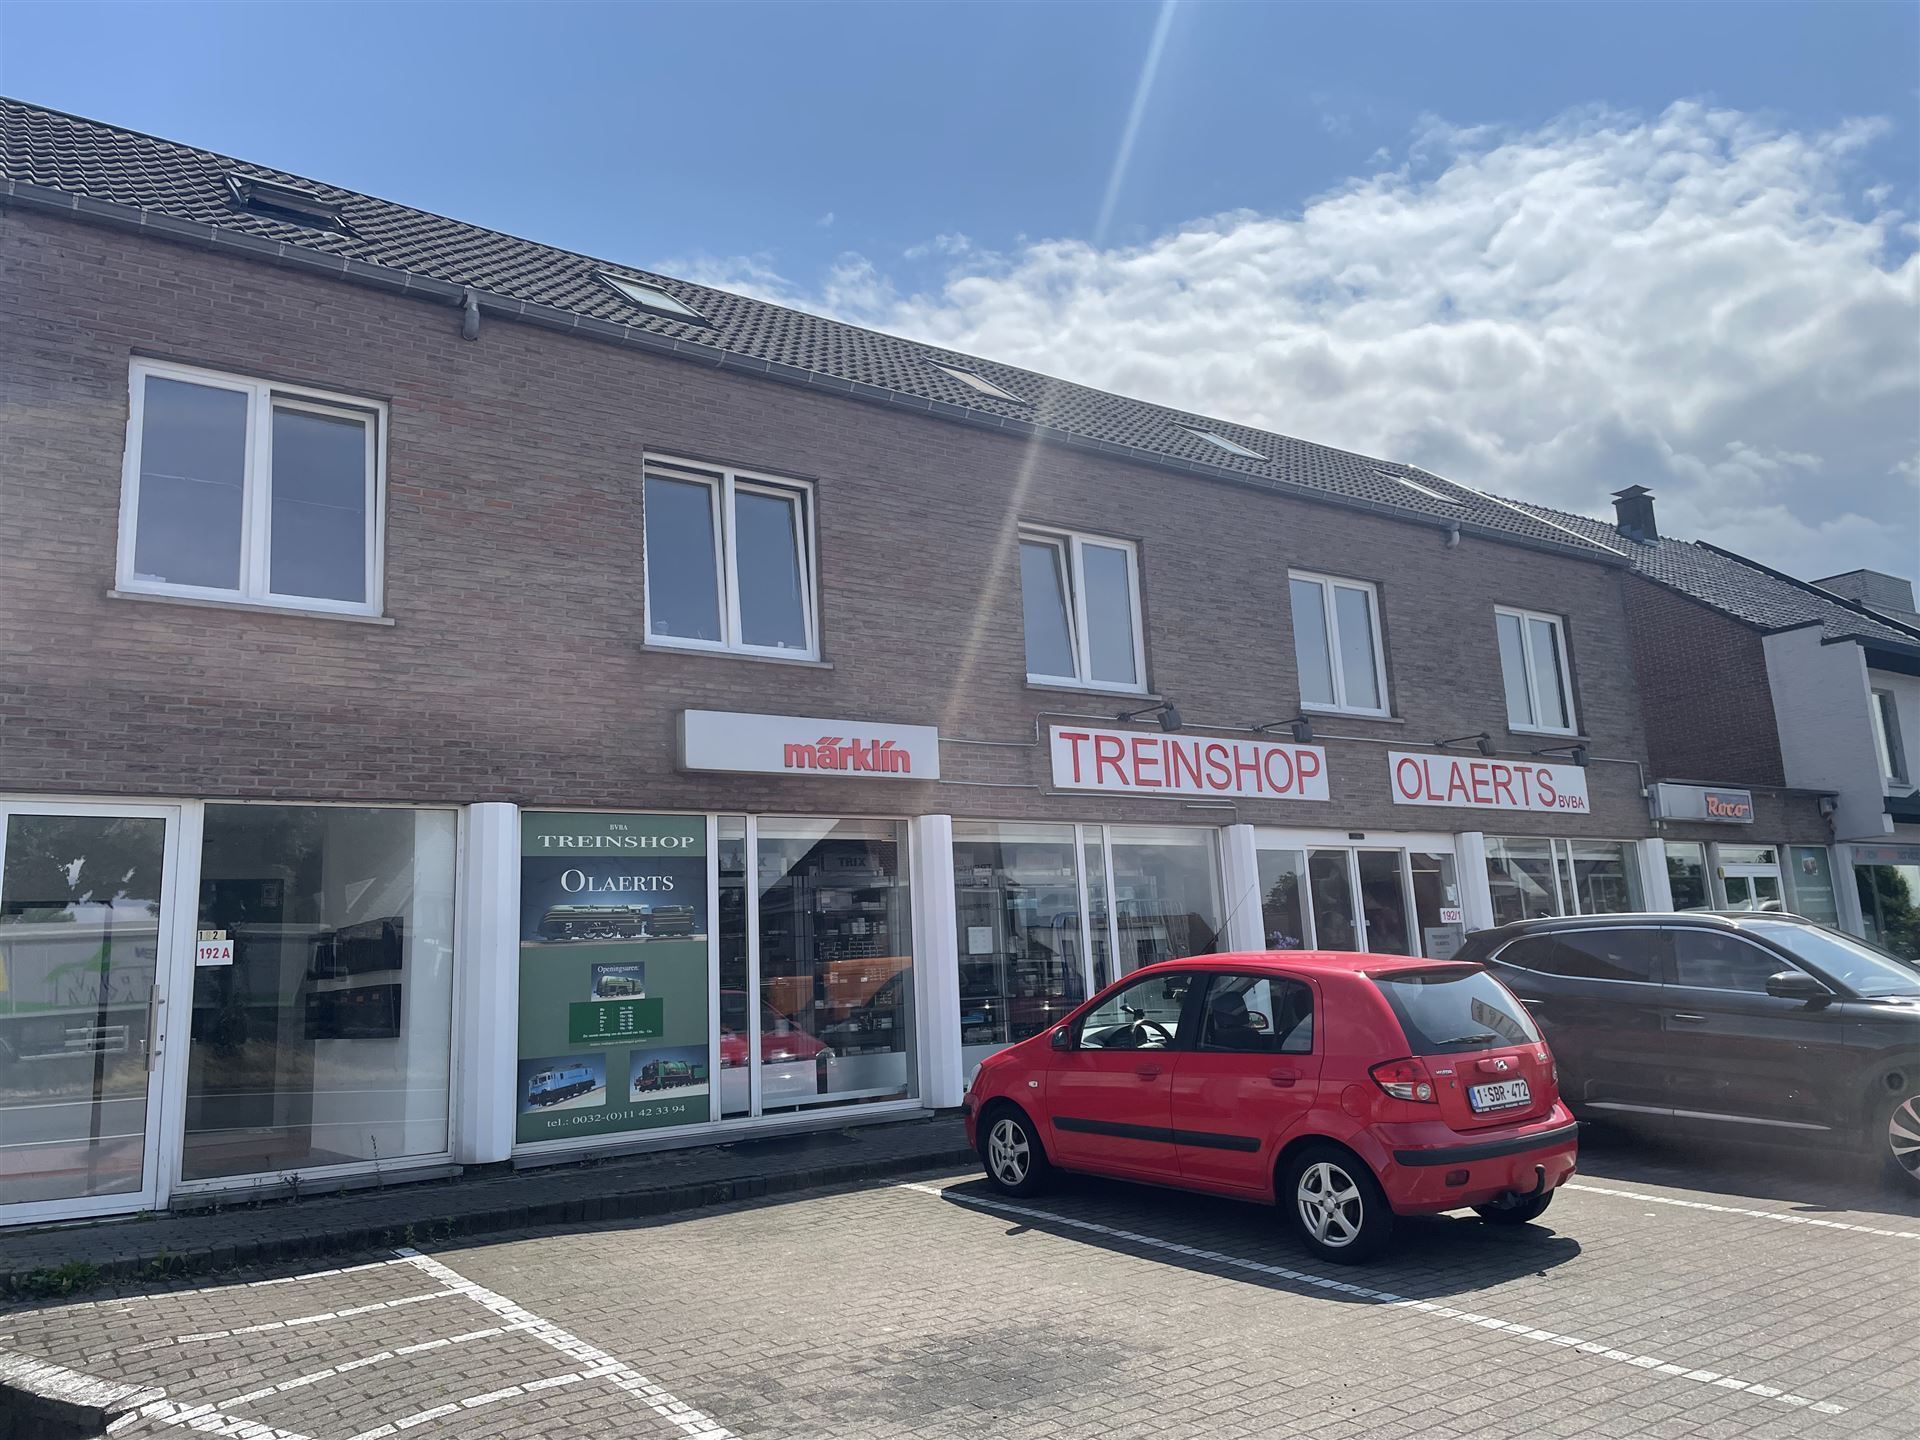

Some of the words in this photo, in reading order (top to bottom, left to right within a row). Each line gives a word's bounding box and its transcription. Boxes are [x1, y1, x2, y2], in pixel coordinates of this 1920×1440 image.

[1058, 732, 1321, 795] TREINSHOP
[1396, 757, 1557, 807] OLAERTS
[1558, 794, 1585, 809] BVBA
[1706, 795, 1749, 817] Roco
[537, 835, 695, 849] TREINSHOP
[839, 856, 866, 867] TRIX
[1443, 911, 1461, 920] 192/1
[200, 947, 219, 958] 192
[222, 947, 229, 958] A
[572, 1110, 634, 1125] 0032-(0)11
[638, 1109, 652, 1117] 42
[655, 1106, 669, 1115] 33
[672, 1104, 686, 1113] 94
